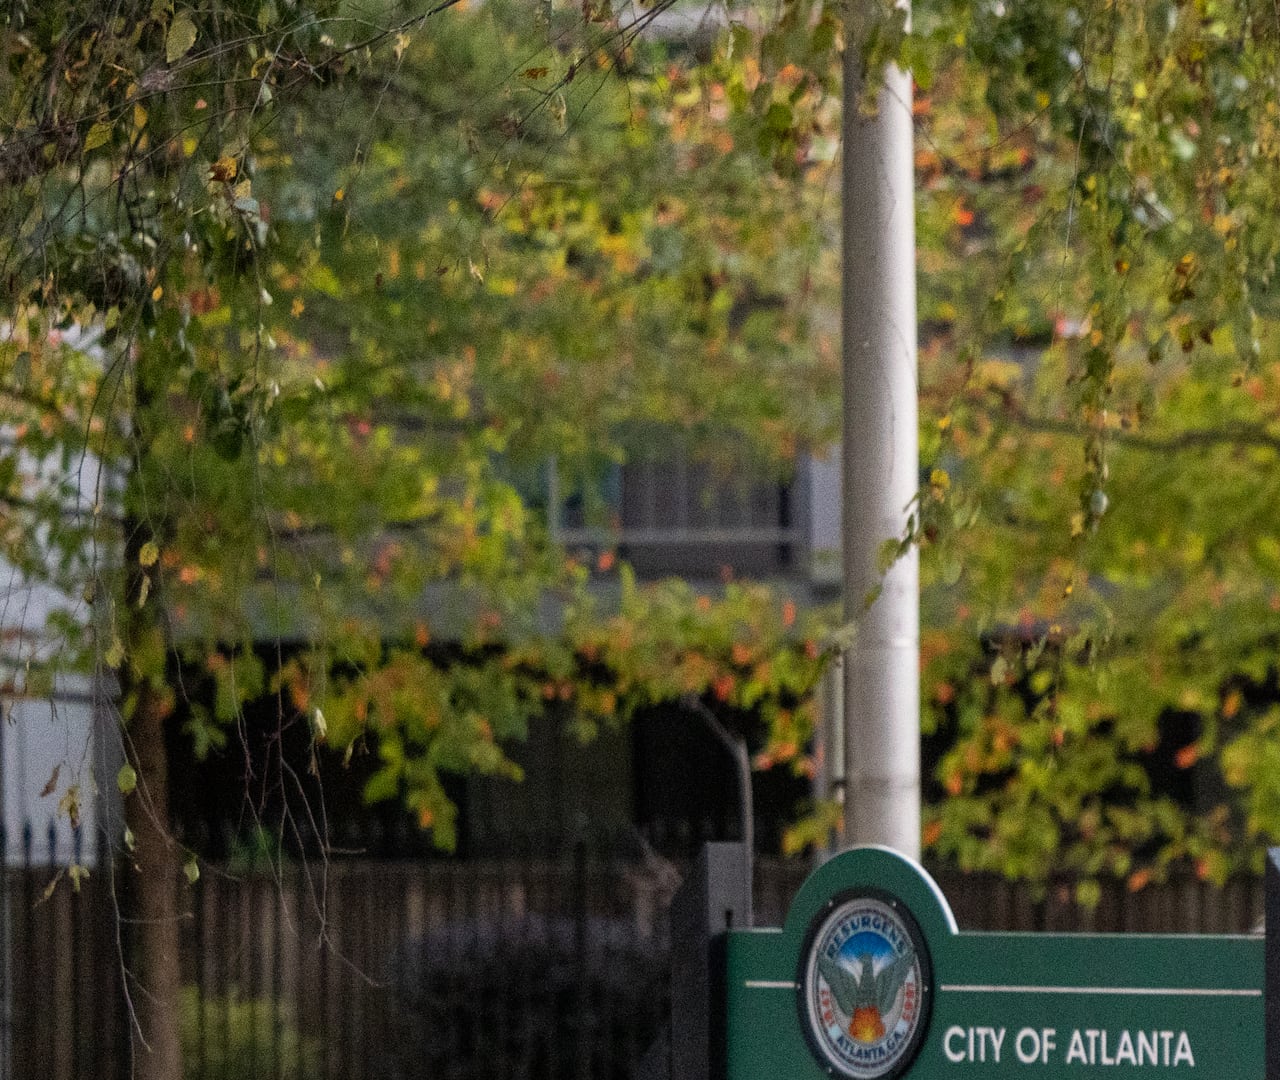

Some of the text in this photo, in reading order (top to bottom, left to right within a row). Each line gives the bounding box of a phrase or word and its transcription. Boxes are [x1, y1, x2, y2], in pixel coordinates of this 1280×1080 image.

[944, 1026, 1195, 1067] CITY OF ATLANTA
